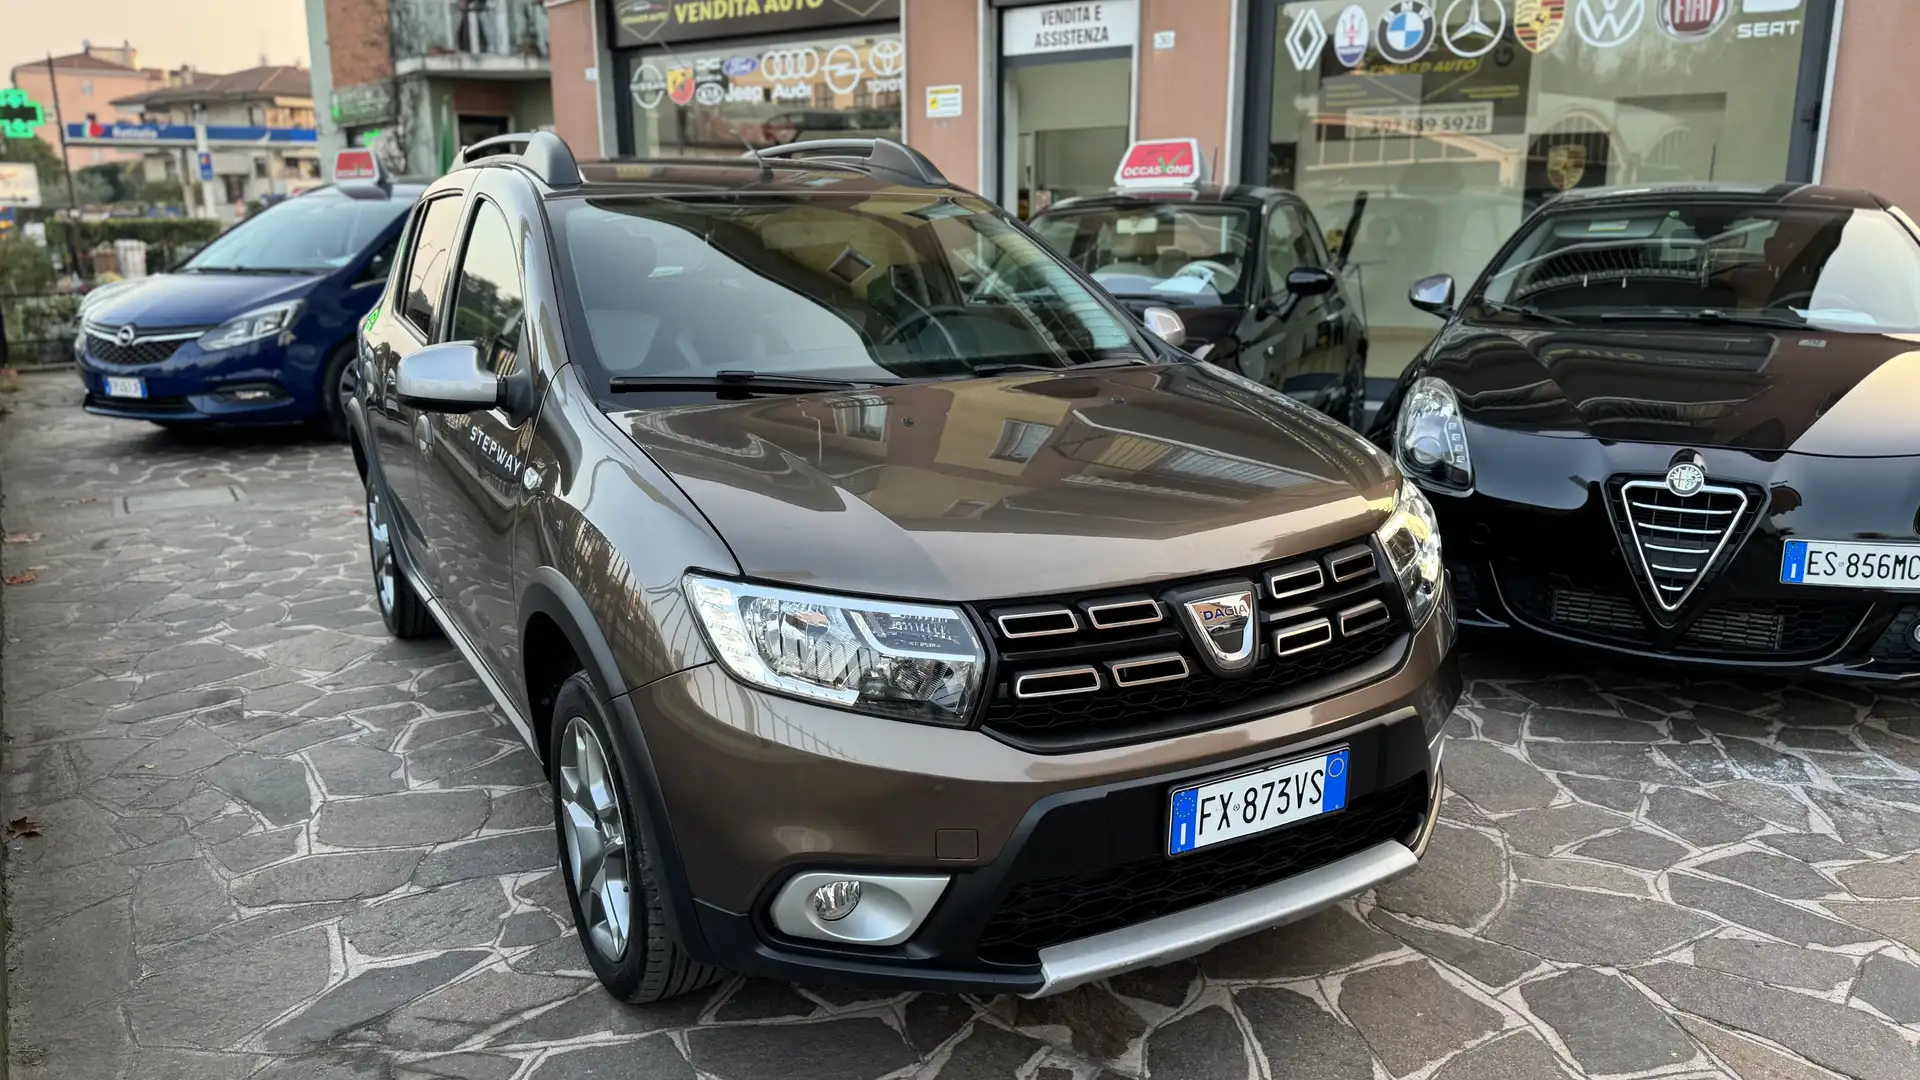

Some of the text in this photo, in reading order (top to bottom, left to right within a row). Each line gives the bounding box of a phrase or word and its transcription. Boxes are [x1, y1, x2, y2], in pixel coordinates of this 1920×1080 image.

[674, 0, 760, 24] VENDITA
[1040, 5, 1103, 28] VENDITA E
[1034, 26, 1110, 48] ASSISTENZA
[1736, 20, 1801, 39] SEAT
[1433, 58, 1477, 72] AUTO
[771, 80, 812, 99] Audi
[1442, 115, 1487, 131] 5928
[1123, 164, 1192, 177] OCCASONE
[469, 425, 522, 476] STEPWAY
